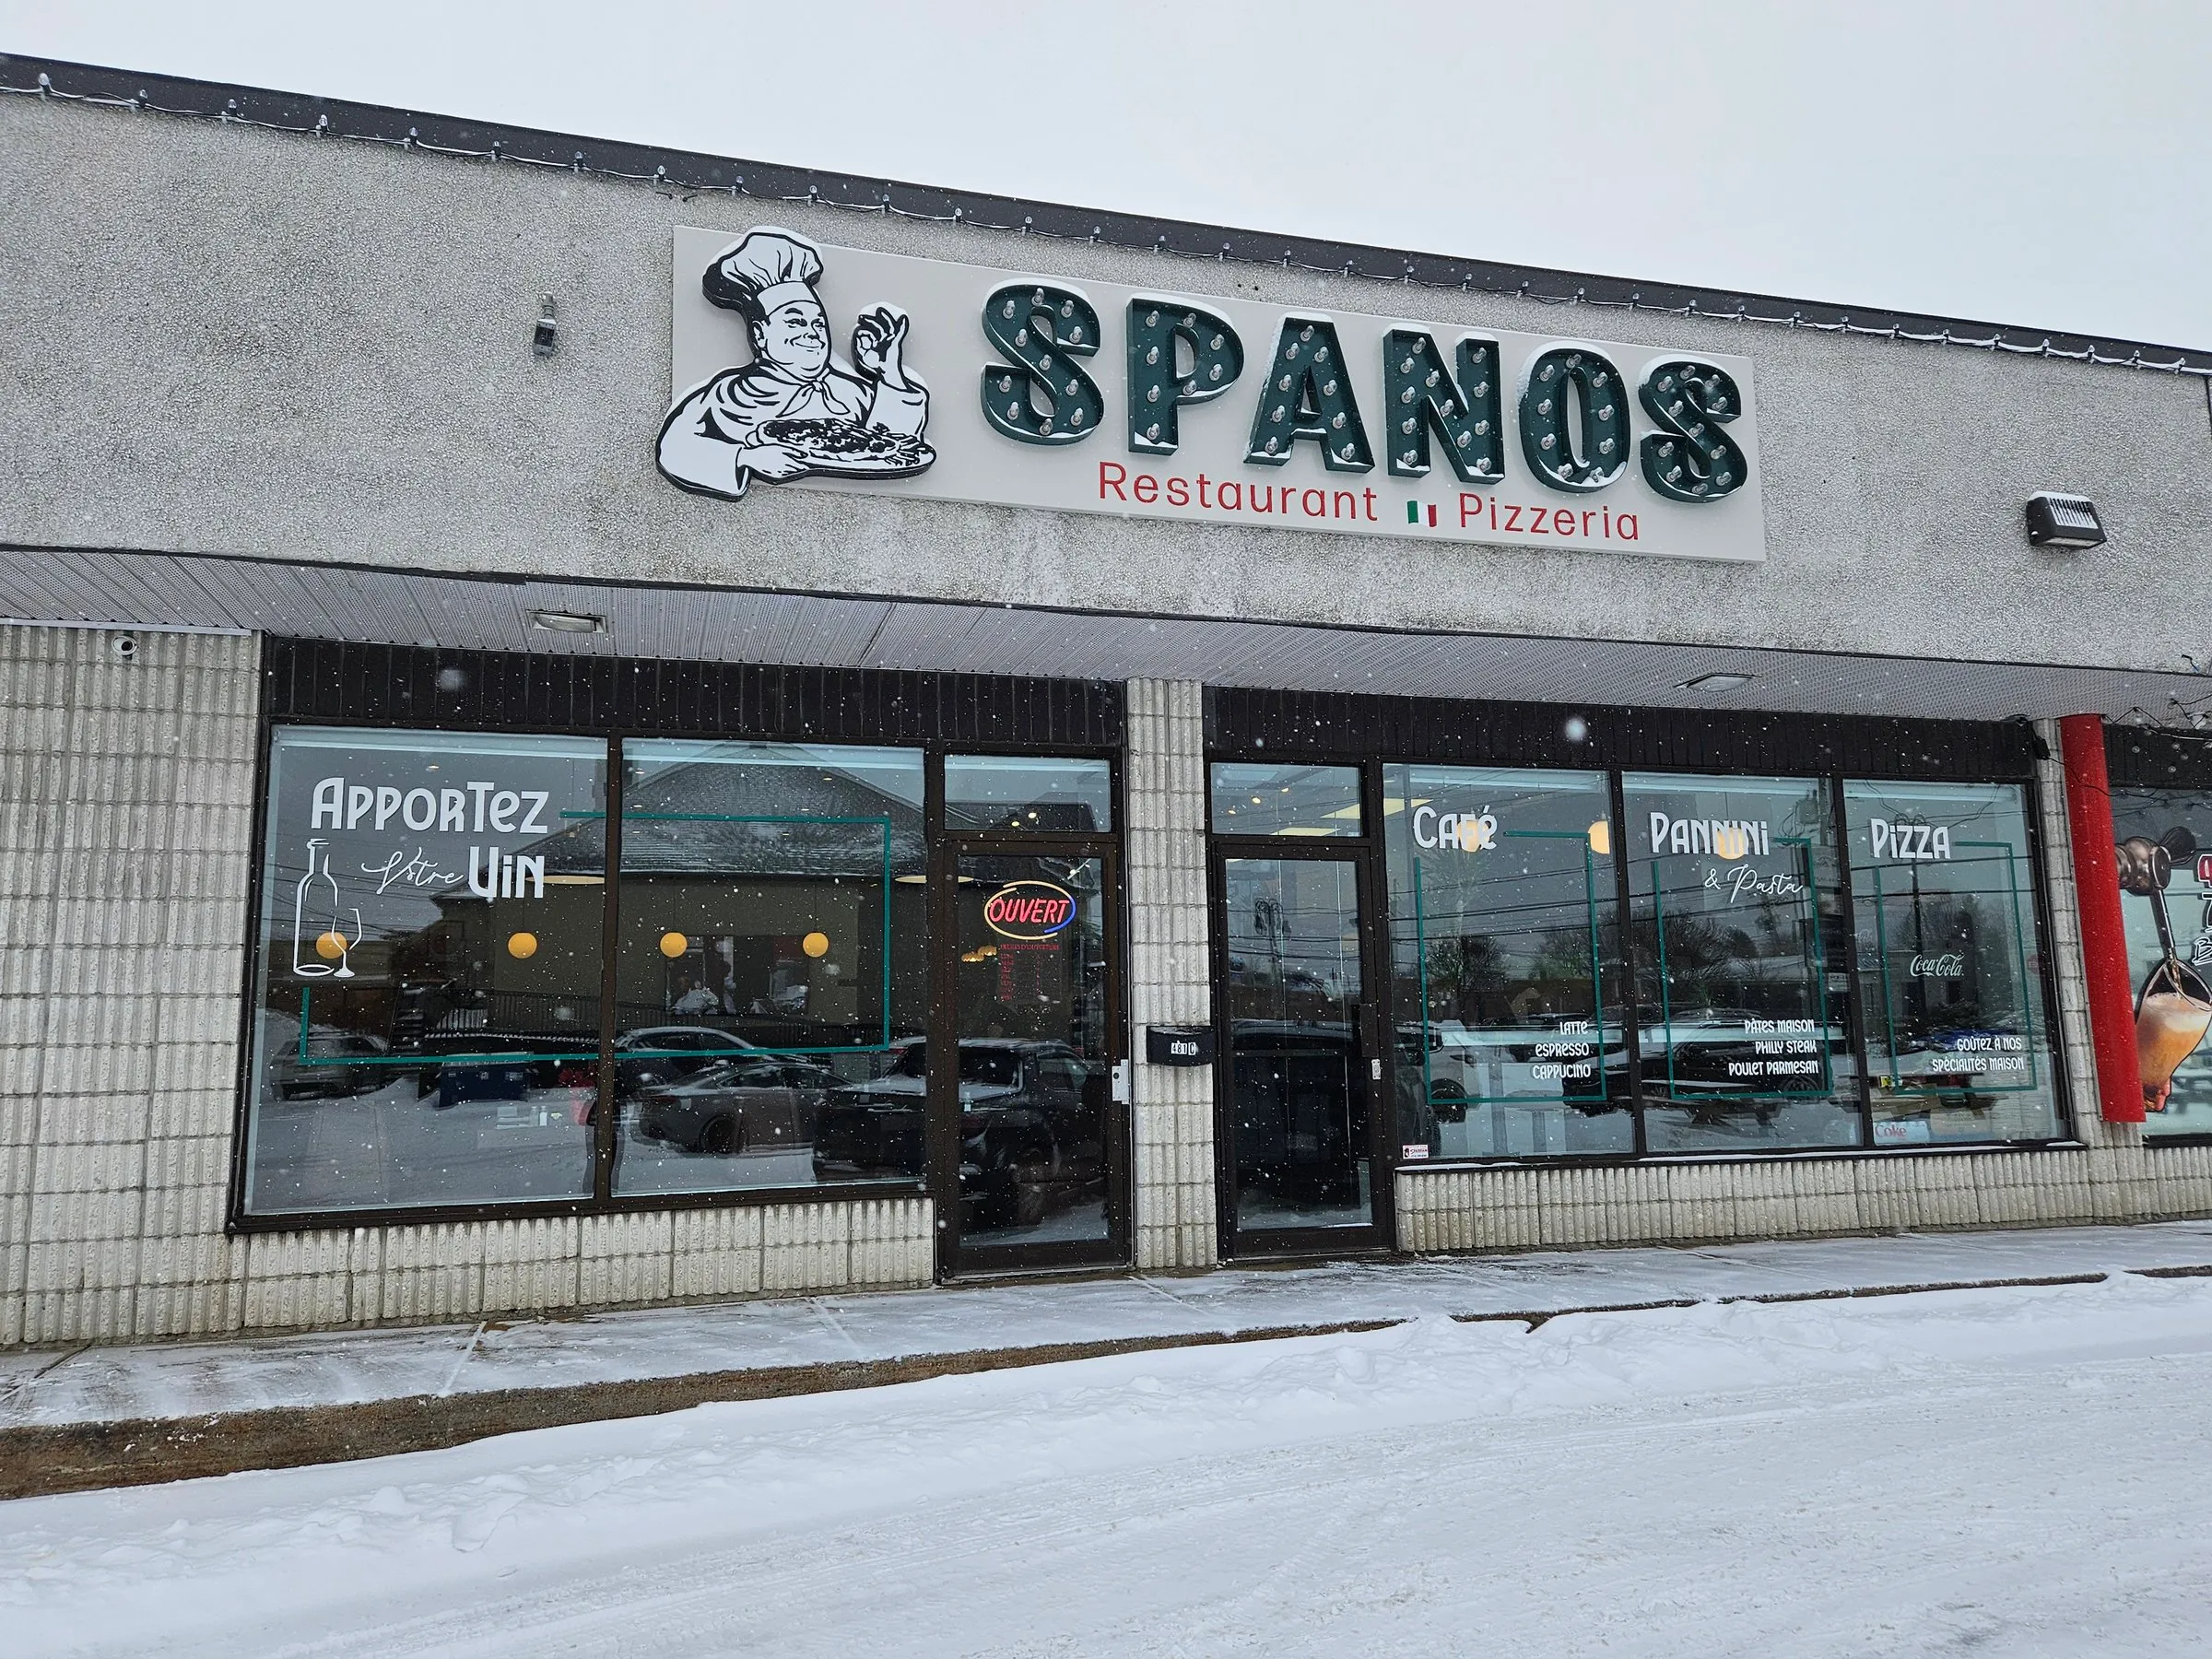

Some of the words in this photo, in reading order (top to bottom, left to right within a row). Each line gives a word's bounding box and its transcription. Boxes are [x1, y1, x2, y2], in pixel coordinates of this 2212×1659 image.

[982, 276, 1748, 504] SPANOS
[1098, 461, 1379, 523] Restaurant
[1459, 493, 1641, 541] Pizzeria
[311, 777, 549, 834] APPORTEZ
[1870, 818, 1951, 859] PIZZA
[1705, 868, 1721, 890] &
[1727, 864, 1804, 903] Pasta
[988, 898, 1070, 924] OUVERT
[1559, 1021, 1589, 1035] LATTE
[1745, 1018, 1774, 1034] PÂTES
[1777, 1018, 1815, 1033] MAISON
[1535, 1042, 1589, 1057] ESPRESSO
[1755, 1041, 1783, 1054] PHILLY
[1786, 1040, 1818, 1053] STEAK
[2003, 1037, 2022, 1051] NOS
[1532, 1064, 1592, 1079] CAPPUCINO
[1728, 1061, 1764, 1076] POULET
[1766, 1060, 1819, 1075] PARMESAN
[1989, 1057, 2025, 1071] MAISON
[1875, 1124, 1907, 1138] Coke
